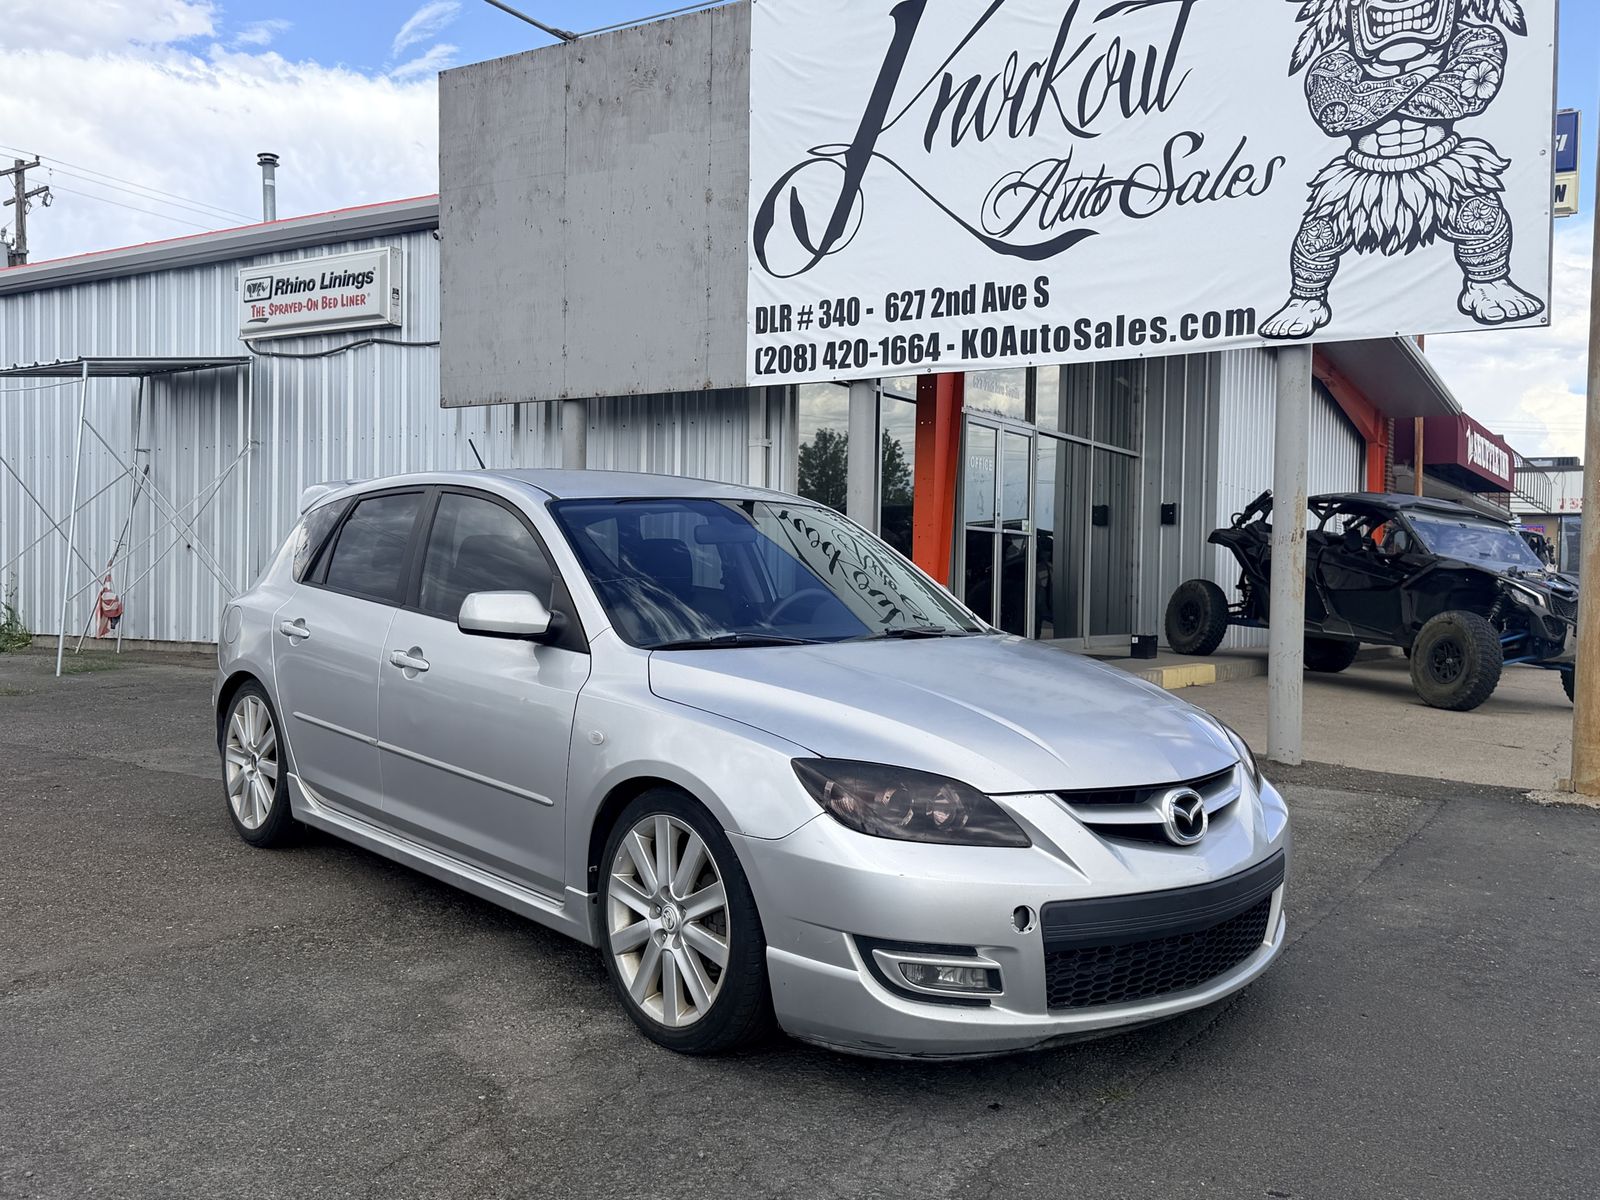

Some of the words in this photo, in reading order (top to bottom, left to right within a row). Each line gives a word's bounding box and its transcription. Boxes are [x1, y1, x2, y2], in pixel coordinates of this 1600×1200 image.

[753, 0, 1193, 279] Knockout
[980, 144, 1114, 237] Auto
[1118, 131, 1287, 219] Sales
[251, 304, 266, 318] THE
[268, 298, 319, 316] SPRAYED-ON
[321, 296, 338, 309] BED
[340, 293, 366, 308] LINER
[274, 276, 316, 296] Rhino
[319, 269, 375, 290] Linings
[755, 304, 792, 334] DLR
[797, 304, 814, 331] #
[818, 297, 860, 329] 340
[885, 289, 926, 323] 627
[930, 283, 976, 318] 2nd
[981, 282, 1027, 314] Ave
[1033, 275, 1050, 308] S
[755, 343, 817, 375] (208)
[822, 332, 942, 370] 420-1664
[961, 307, 1256, 360] KOAutoSales.com
[970, 455, 993, 471] OFFICE
